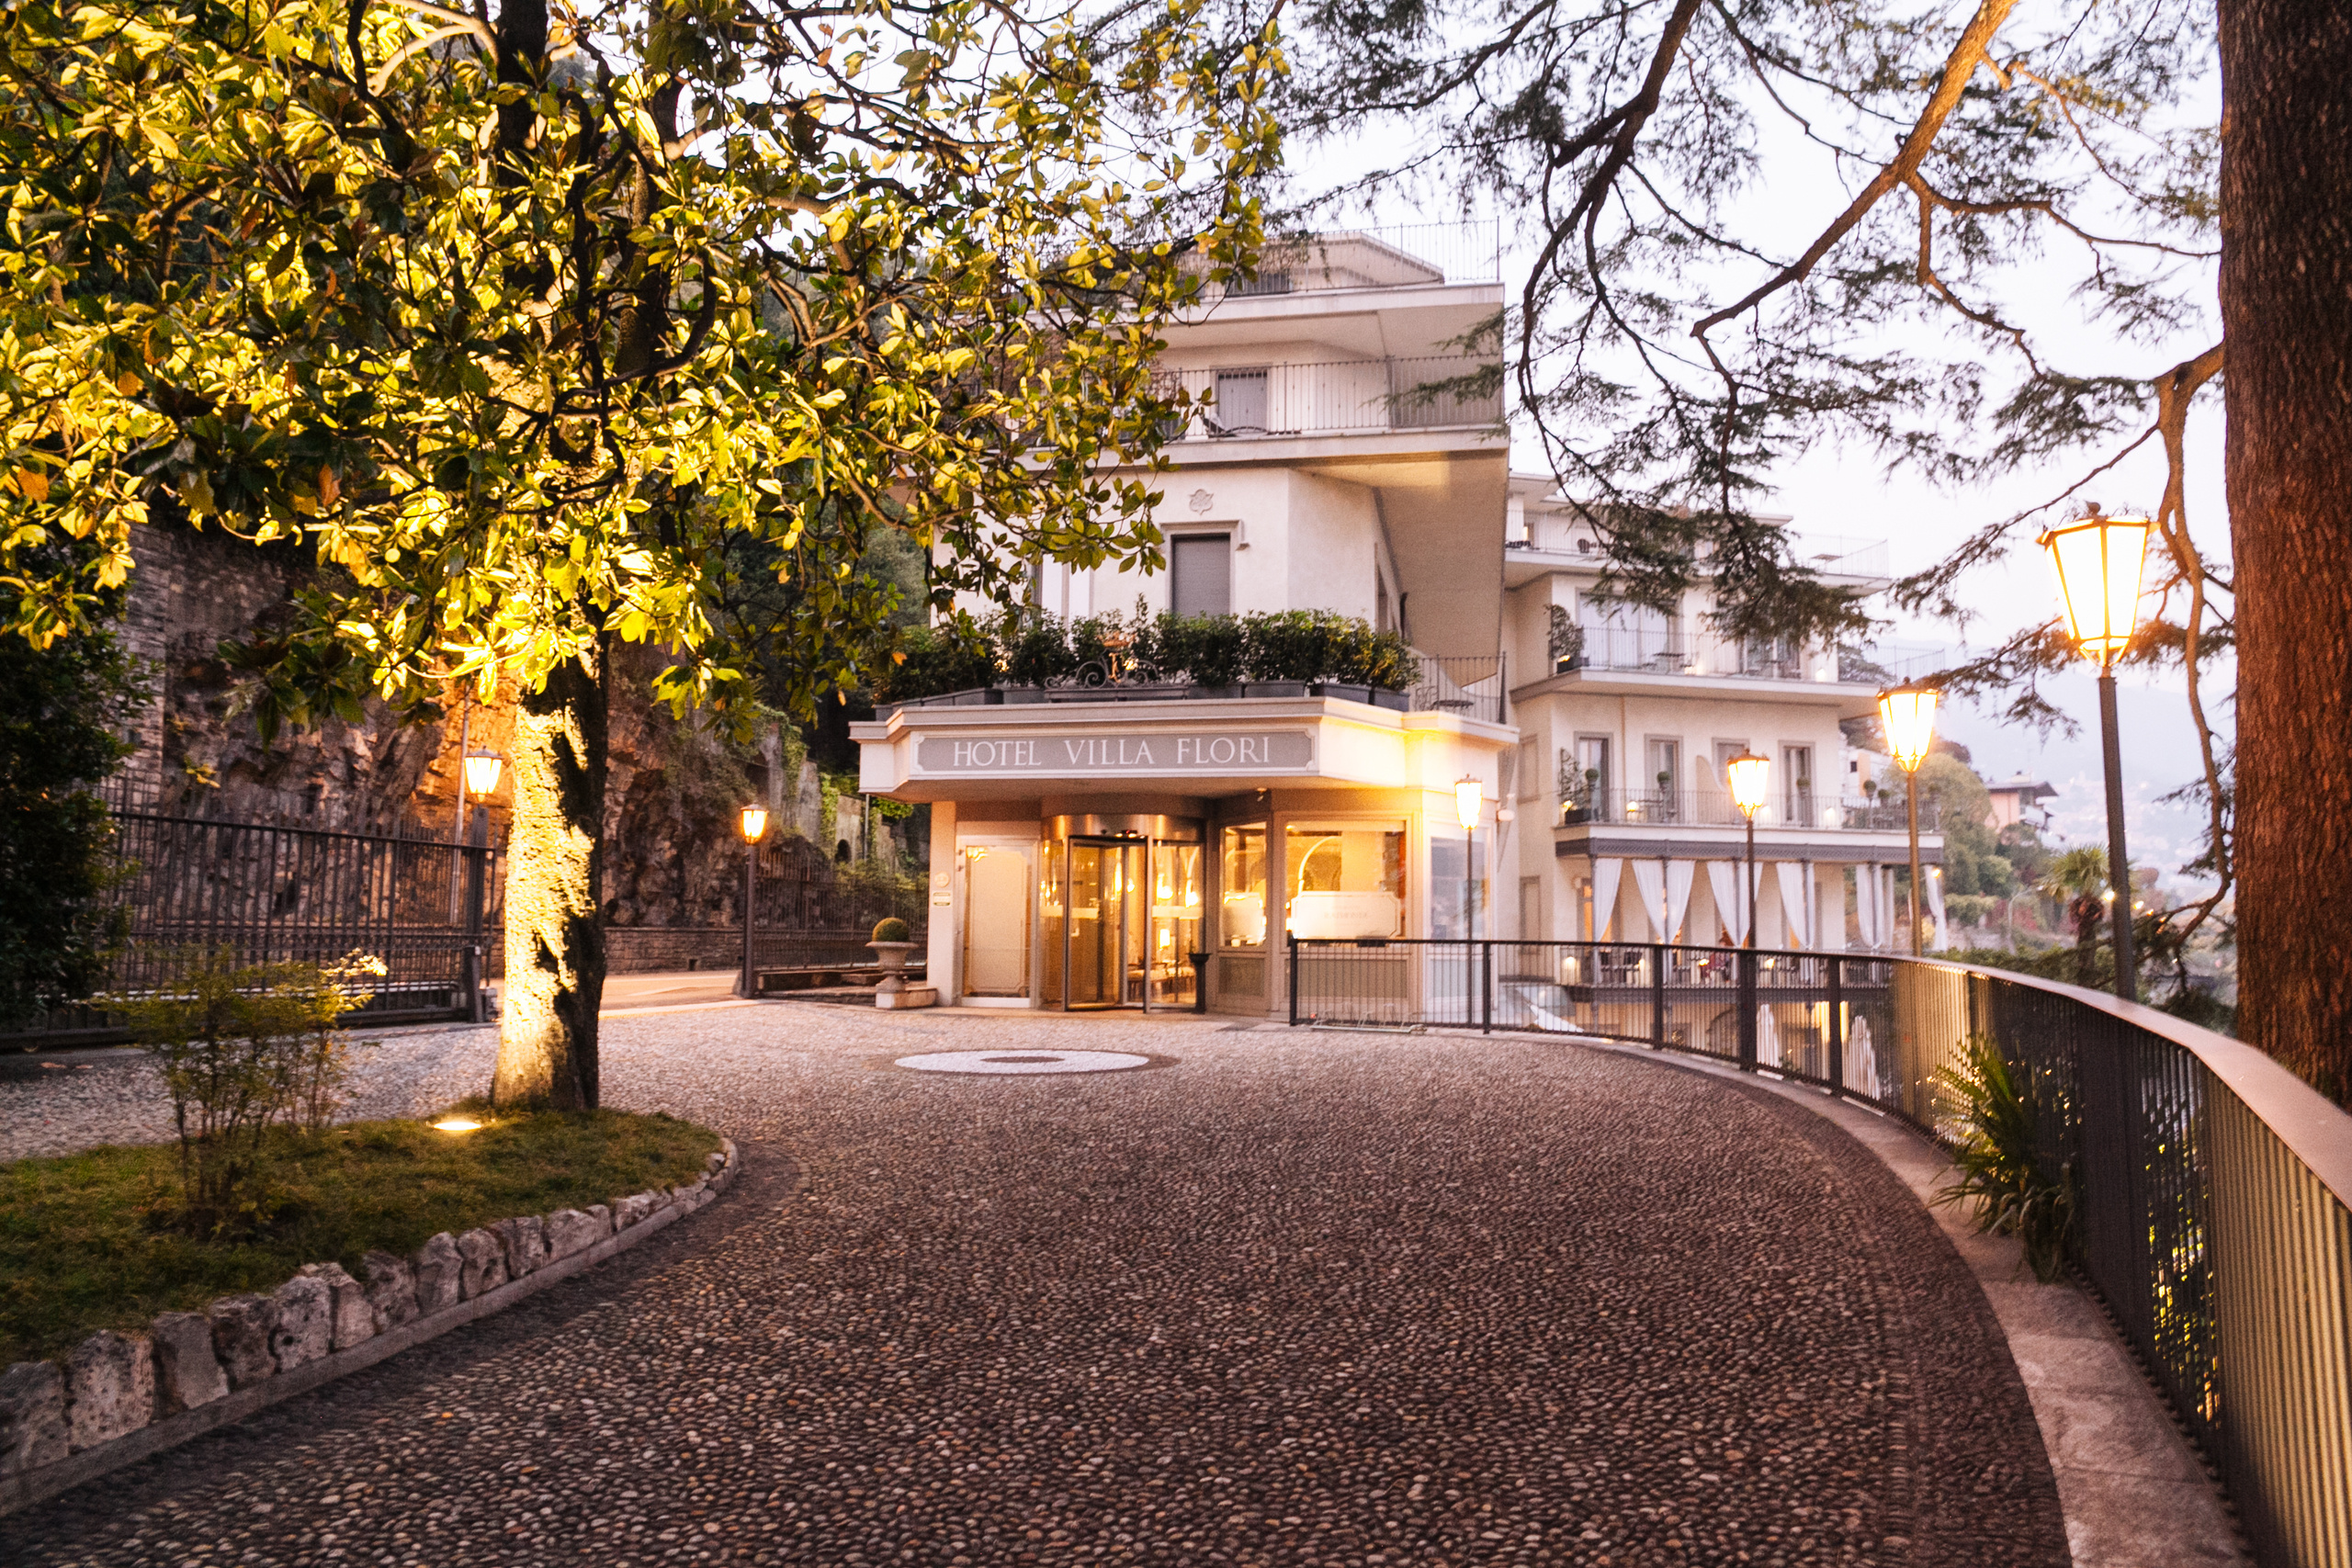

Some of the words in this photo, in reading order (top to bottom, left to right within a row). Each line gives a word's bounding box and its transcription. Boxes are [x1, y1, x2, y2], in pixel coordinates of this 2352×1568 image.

[953, 740, 1042, 766] HOTEL
[1063, 739, 1155, 765] VILLA
[1176, 737, 1270, 764] FLORI
